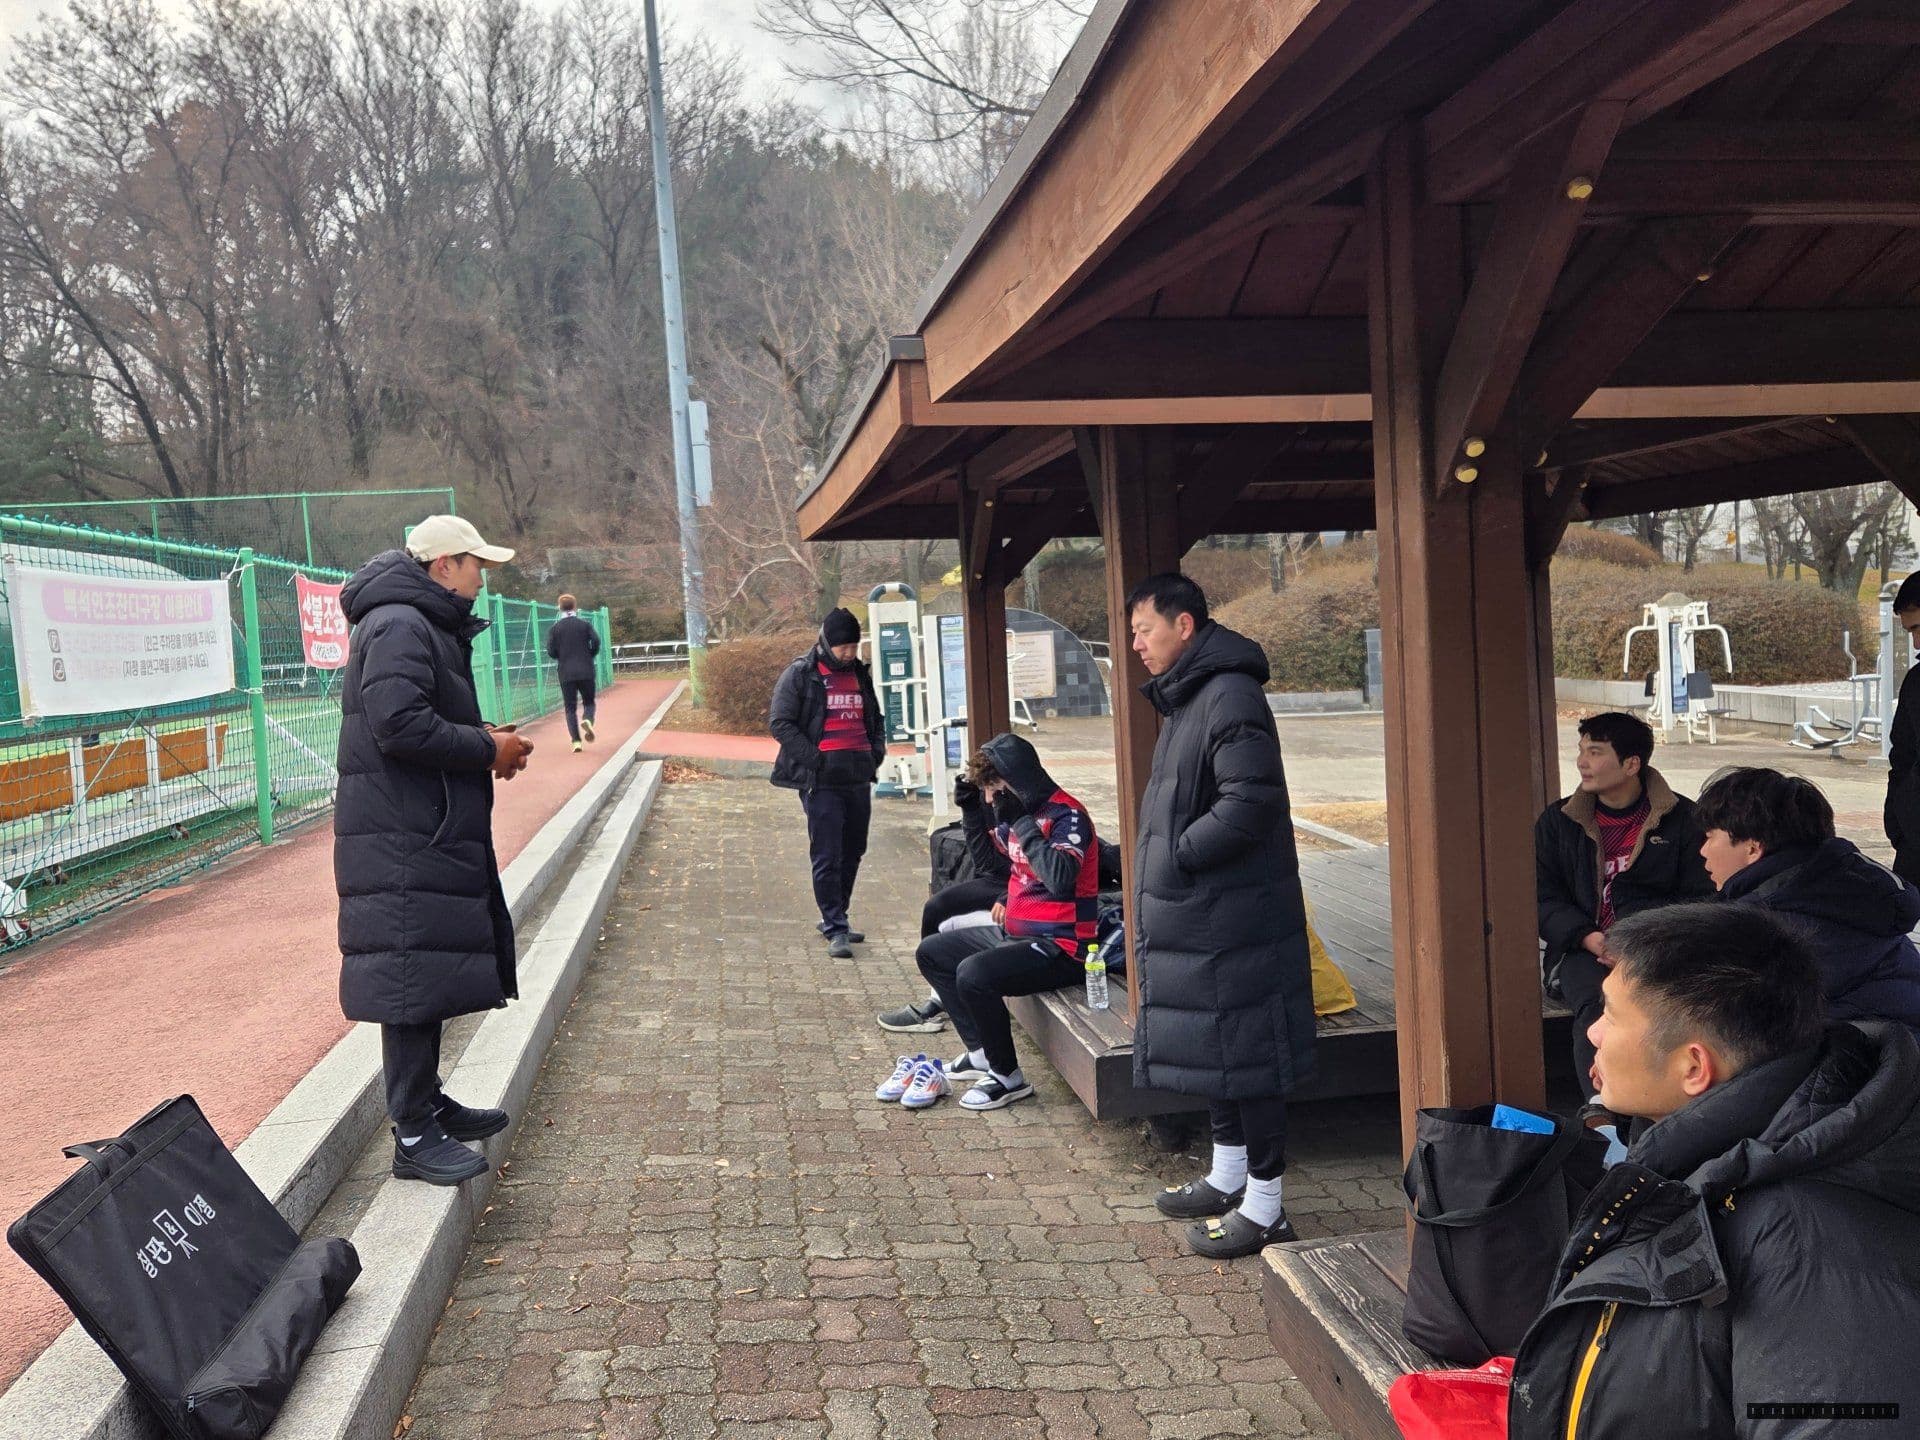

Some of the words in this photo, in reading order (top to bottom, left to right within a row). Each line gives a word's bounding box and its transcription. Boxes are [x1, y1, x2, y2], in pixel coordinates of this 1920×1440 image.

[165, 591, 203, 620] 이용안내
[302, 592, 346, 636] 산불조심
[136, 1235, 172, 1278] 칠판
[163, 1221, 178, 1236] &
